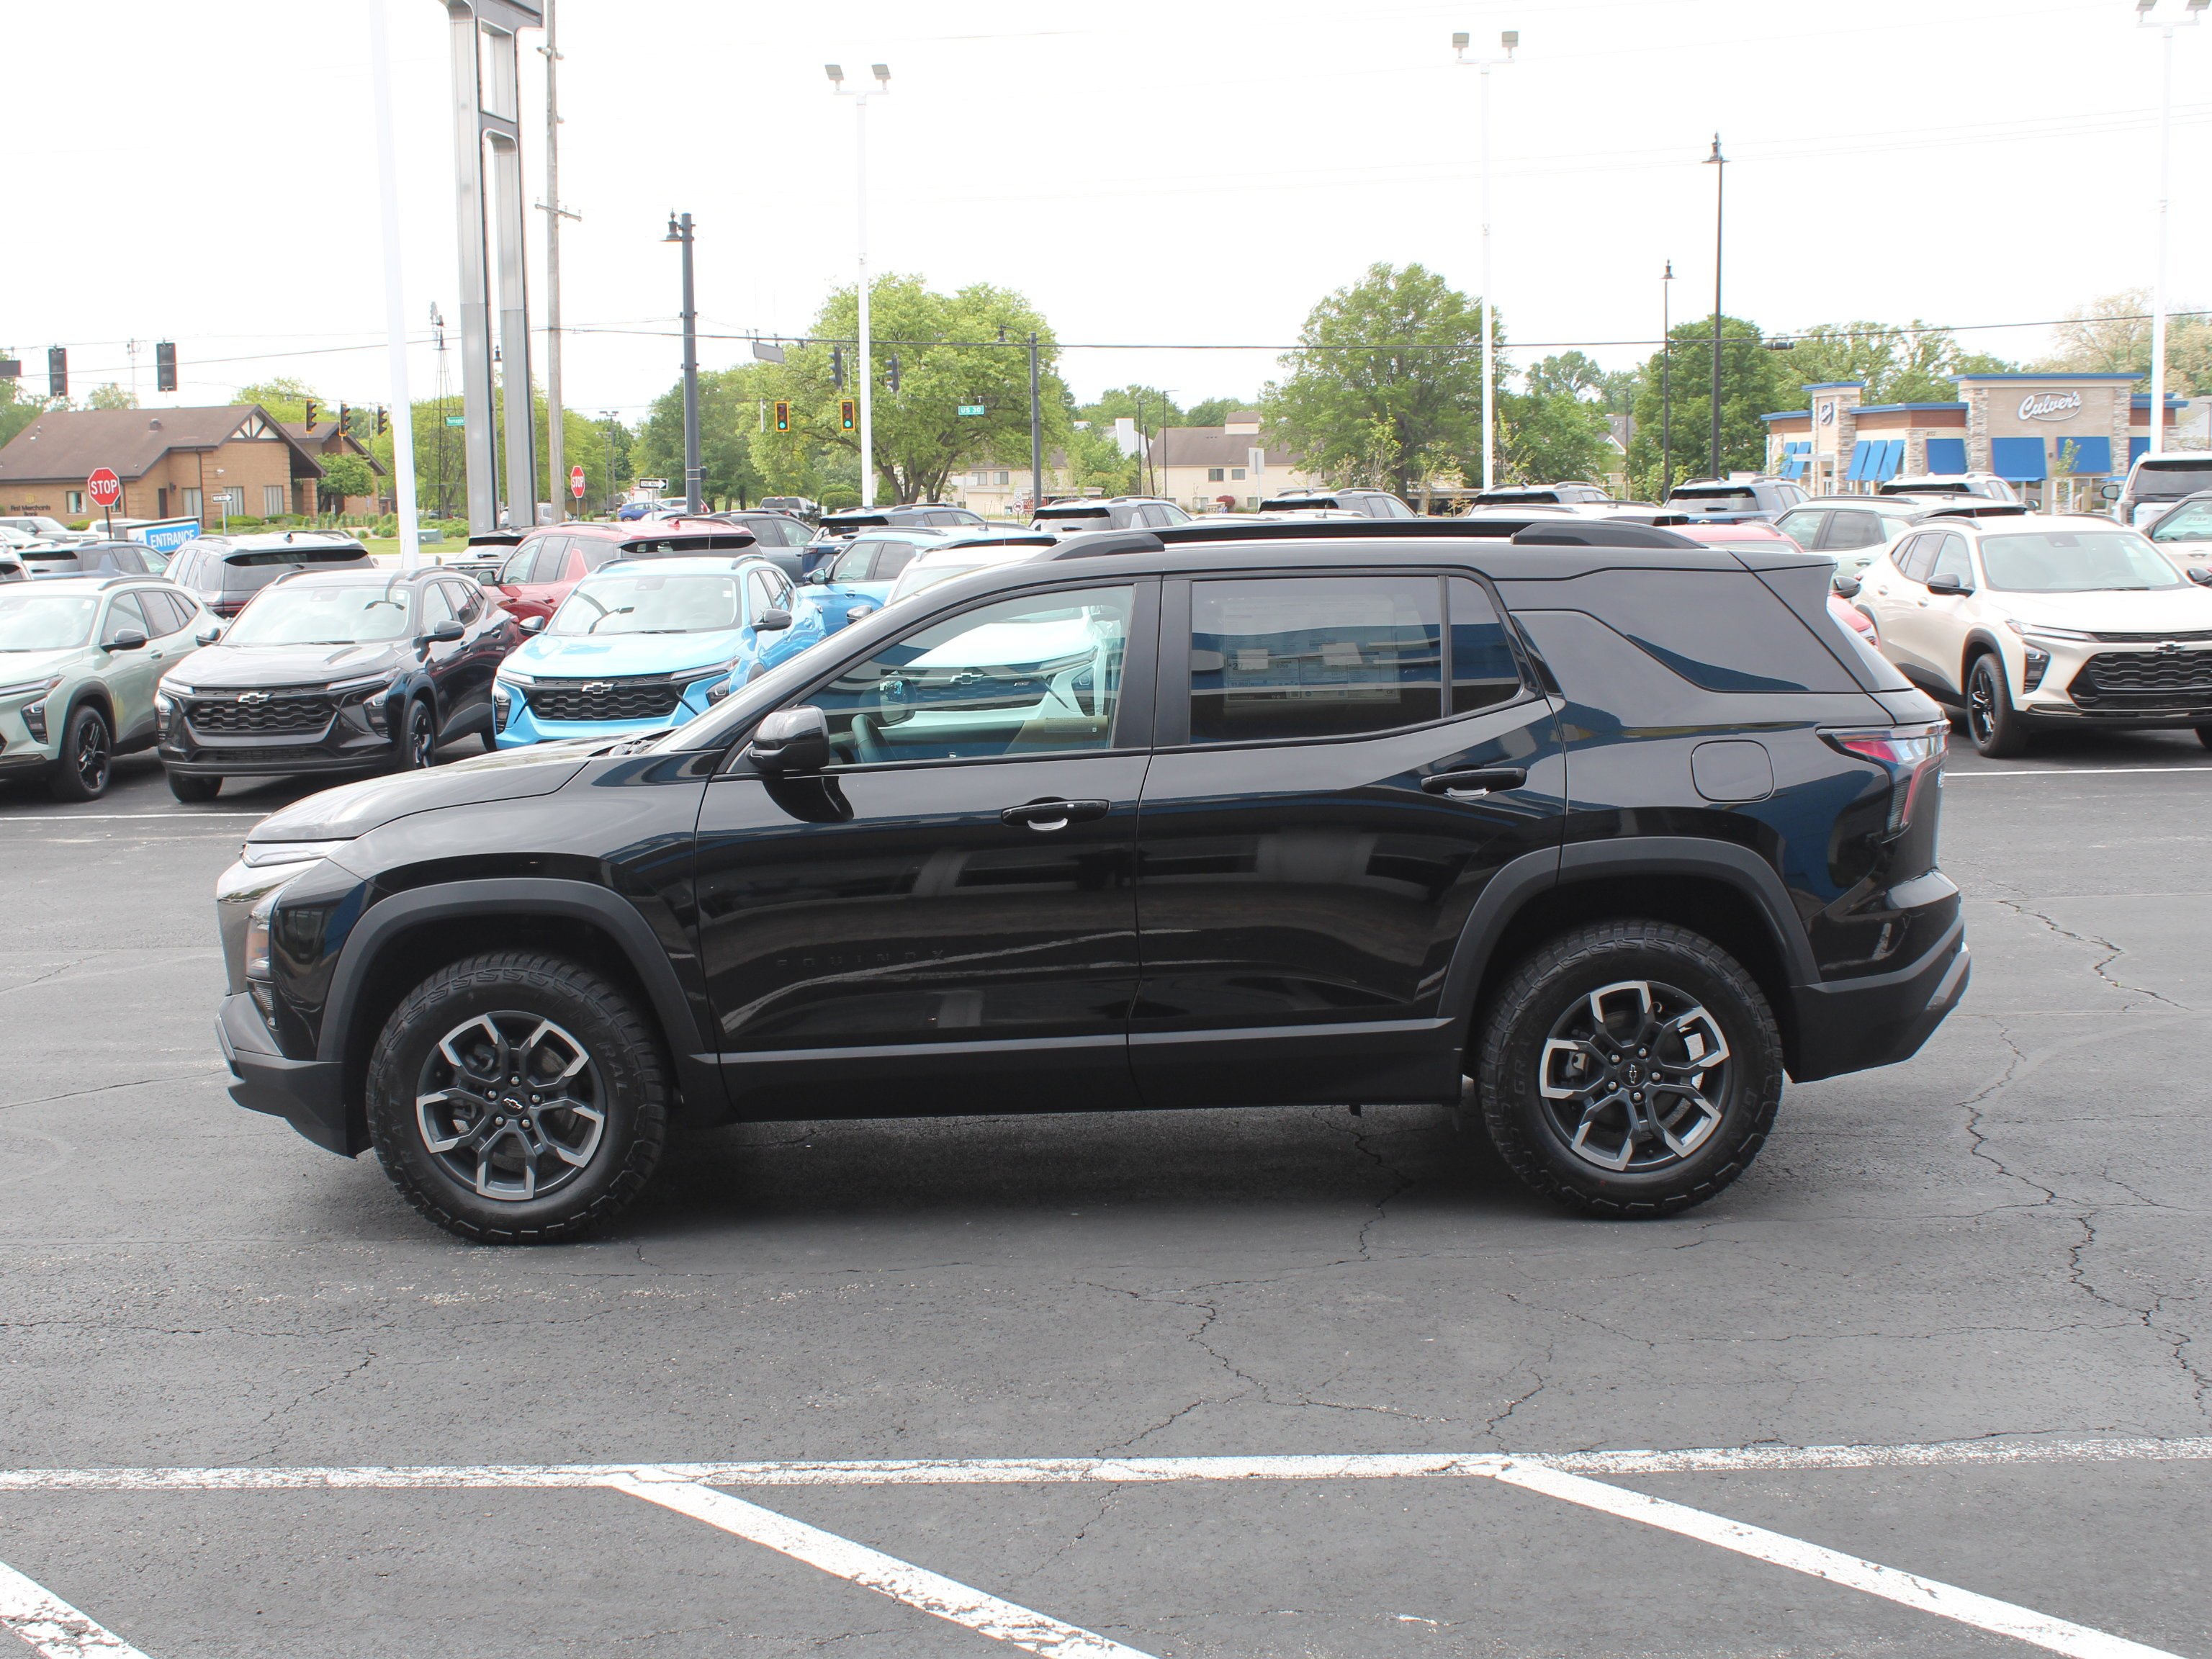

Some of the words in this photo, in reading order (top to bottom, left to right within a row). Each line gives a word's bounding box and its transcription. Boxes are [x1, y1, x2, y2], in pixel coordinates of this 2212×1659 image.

[2018, 391, 2082, 421] Culver's
[91, 479, 117, 495] STOP
[572, 476, 584, 488] STOP
[150, 529, 195, 548] ENTRANCE
